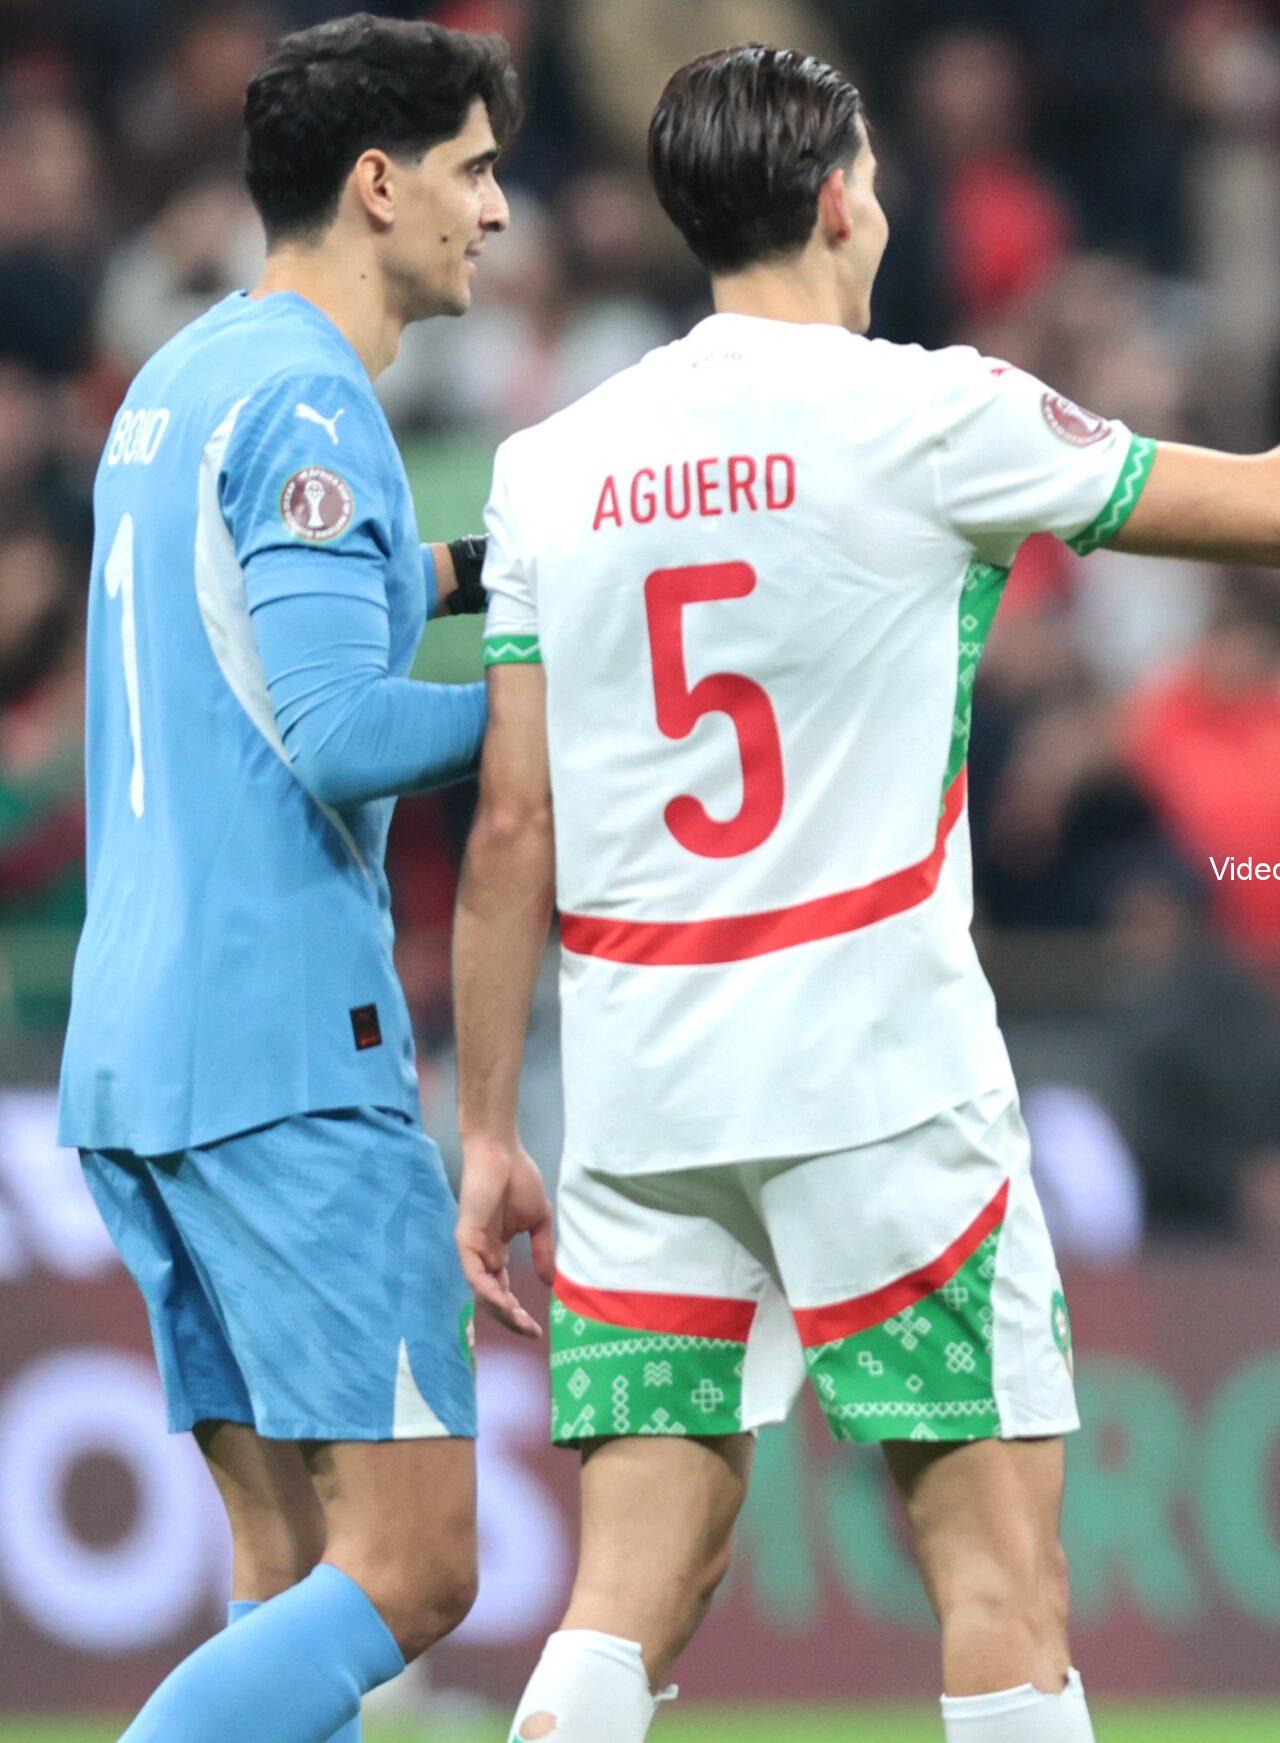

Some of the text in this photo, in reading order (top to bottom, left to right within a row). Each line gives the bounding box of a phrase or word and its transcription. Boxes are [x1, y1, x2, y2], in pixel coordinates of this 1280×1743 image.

[592, 454, 796, 530] AGUERD
[104, 512, 144, 819] 1
[643, 560, 785, 860] 5
